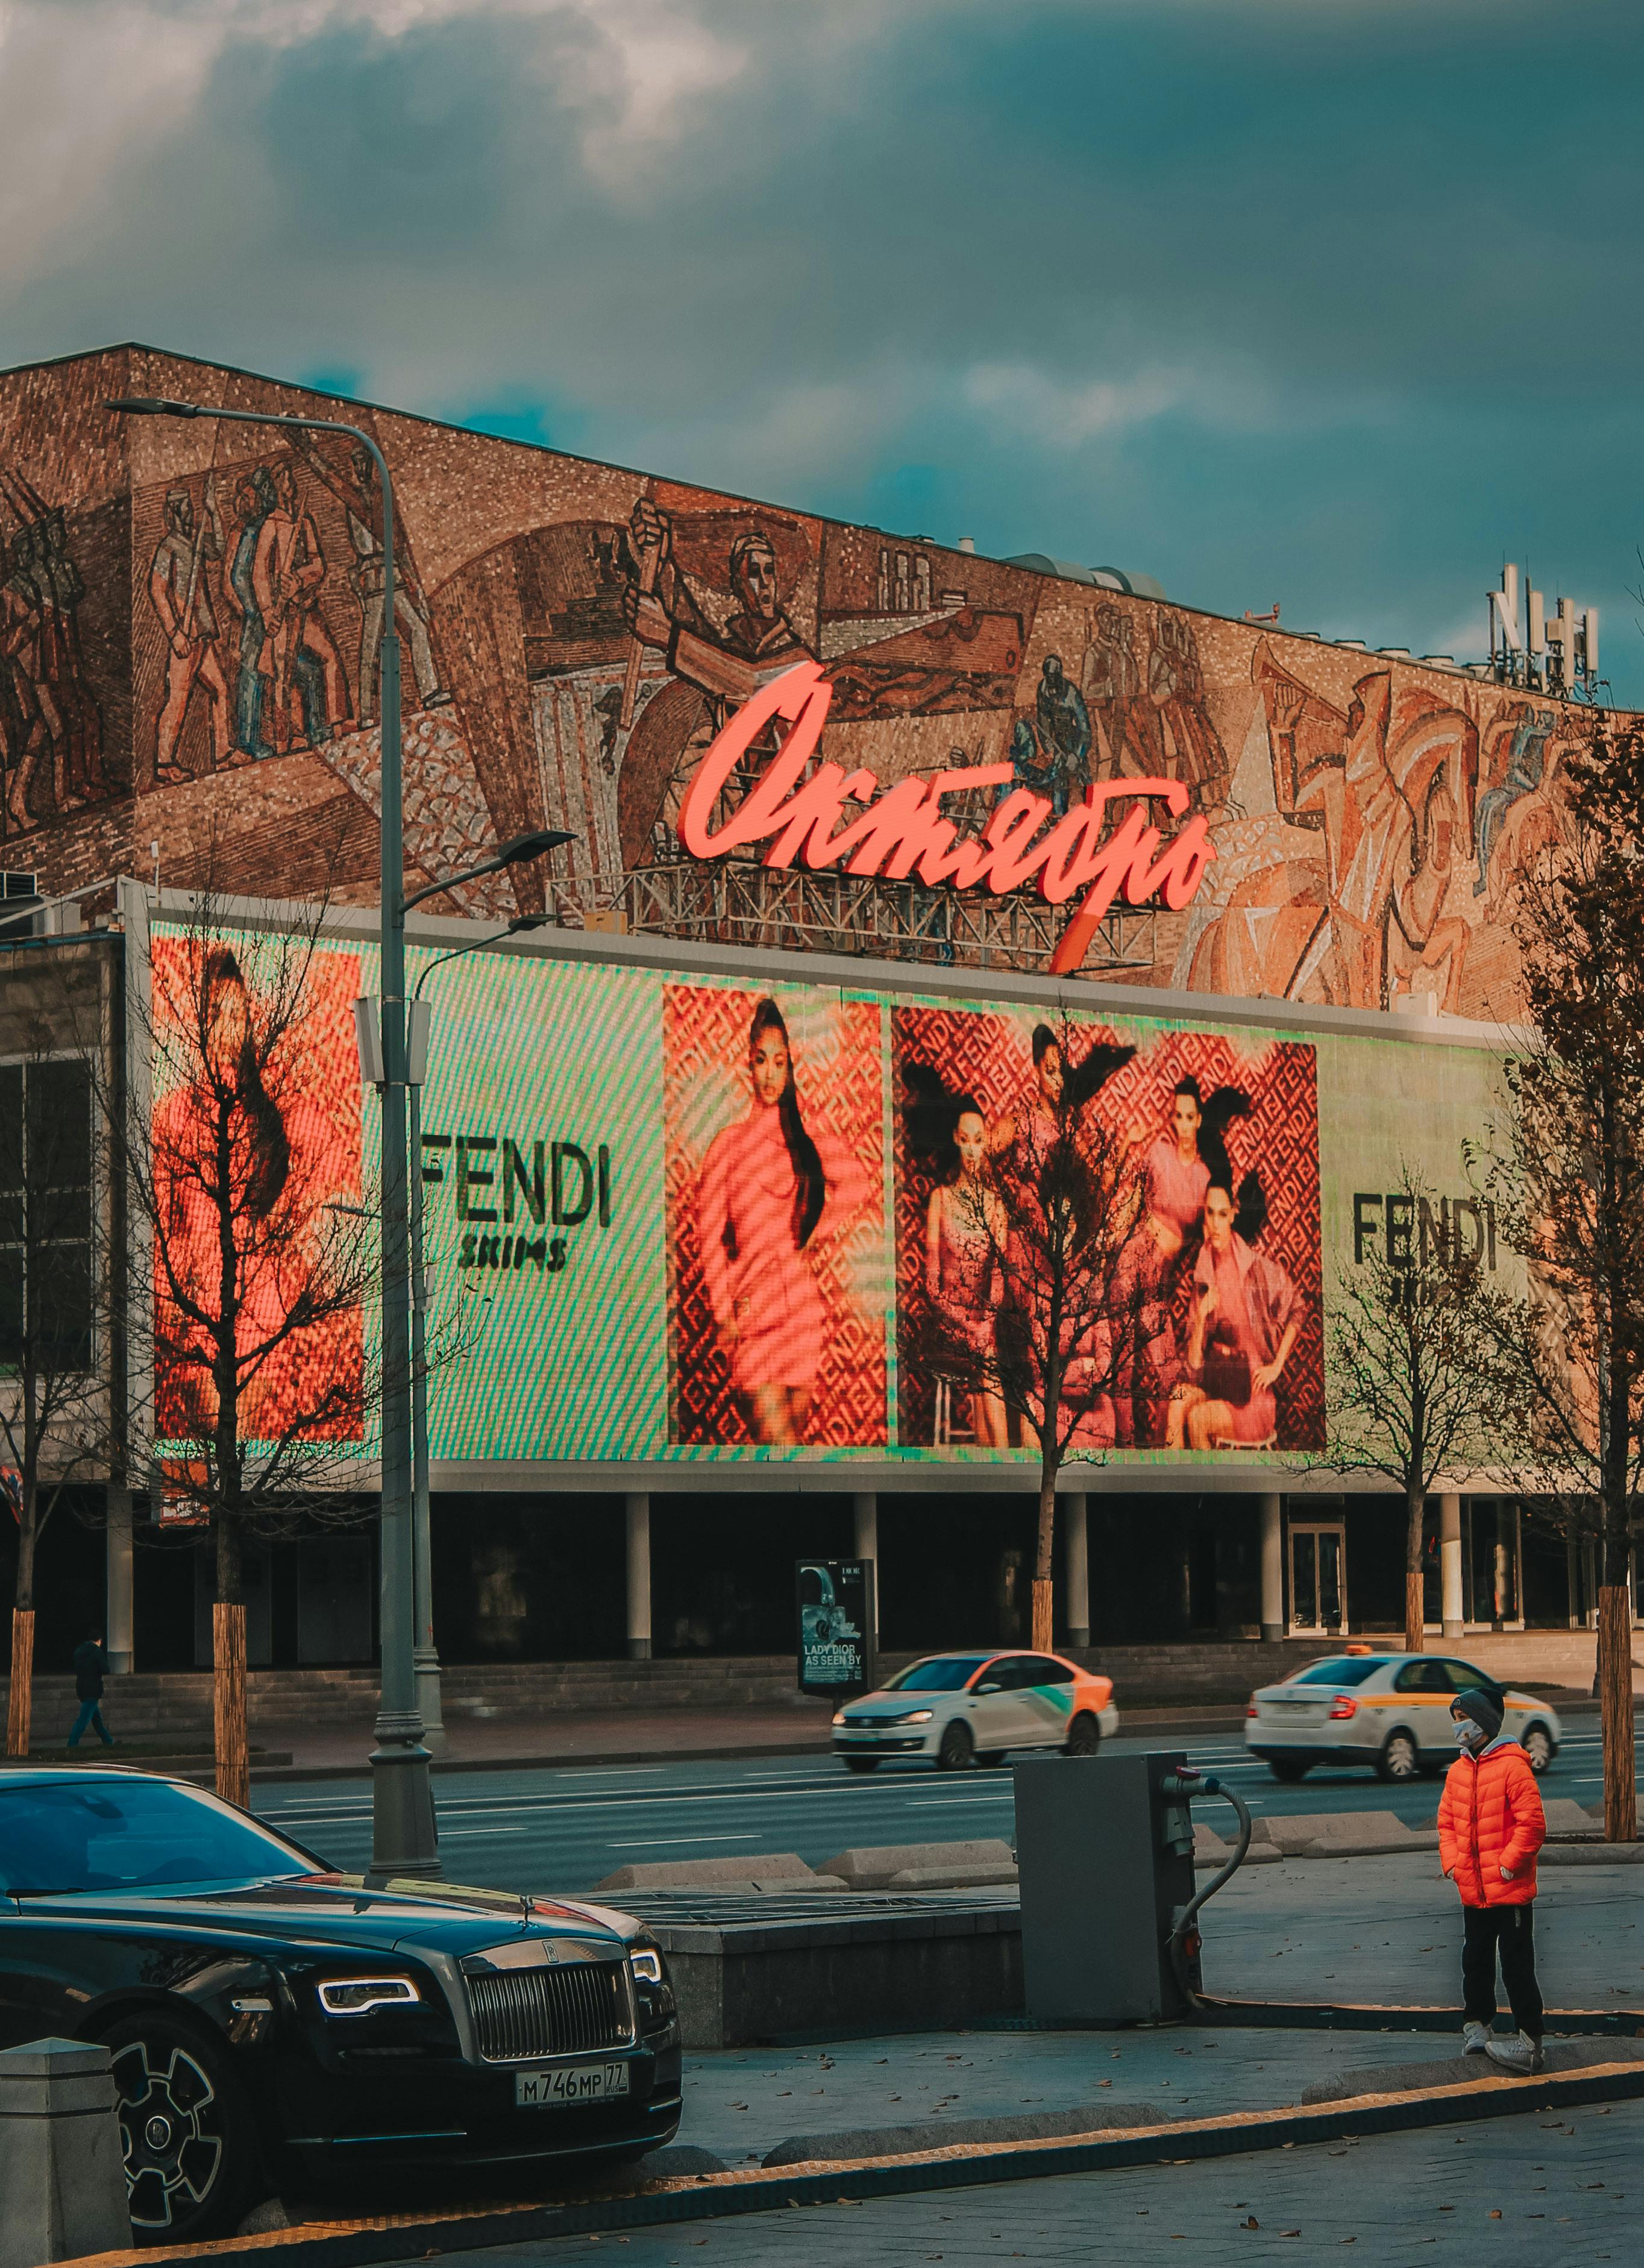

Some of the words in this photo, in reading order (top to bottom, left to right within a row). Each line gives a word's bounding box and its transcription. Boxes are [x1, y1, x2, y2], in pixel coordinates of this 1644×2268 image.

[805, 1645, 830, 1655] LADY
[832, 1644, 855, 1654] DIOR
[805, 1656, 818, 1665] AS
[821, 1656, 847, 1665] SEEN
[849, 1655, 861, 1665] BY
[606, 2064, 623, 2085] 77
